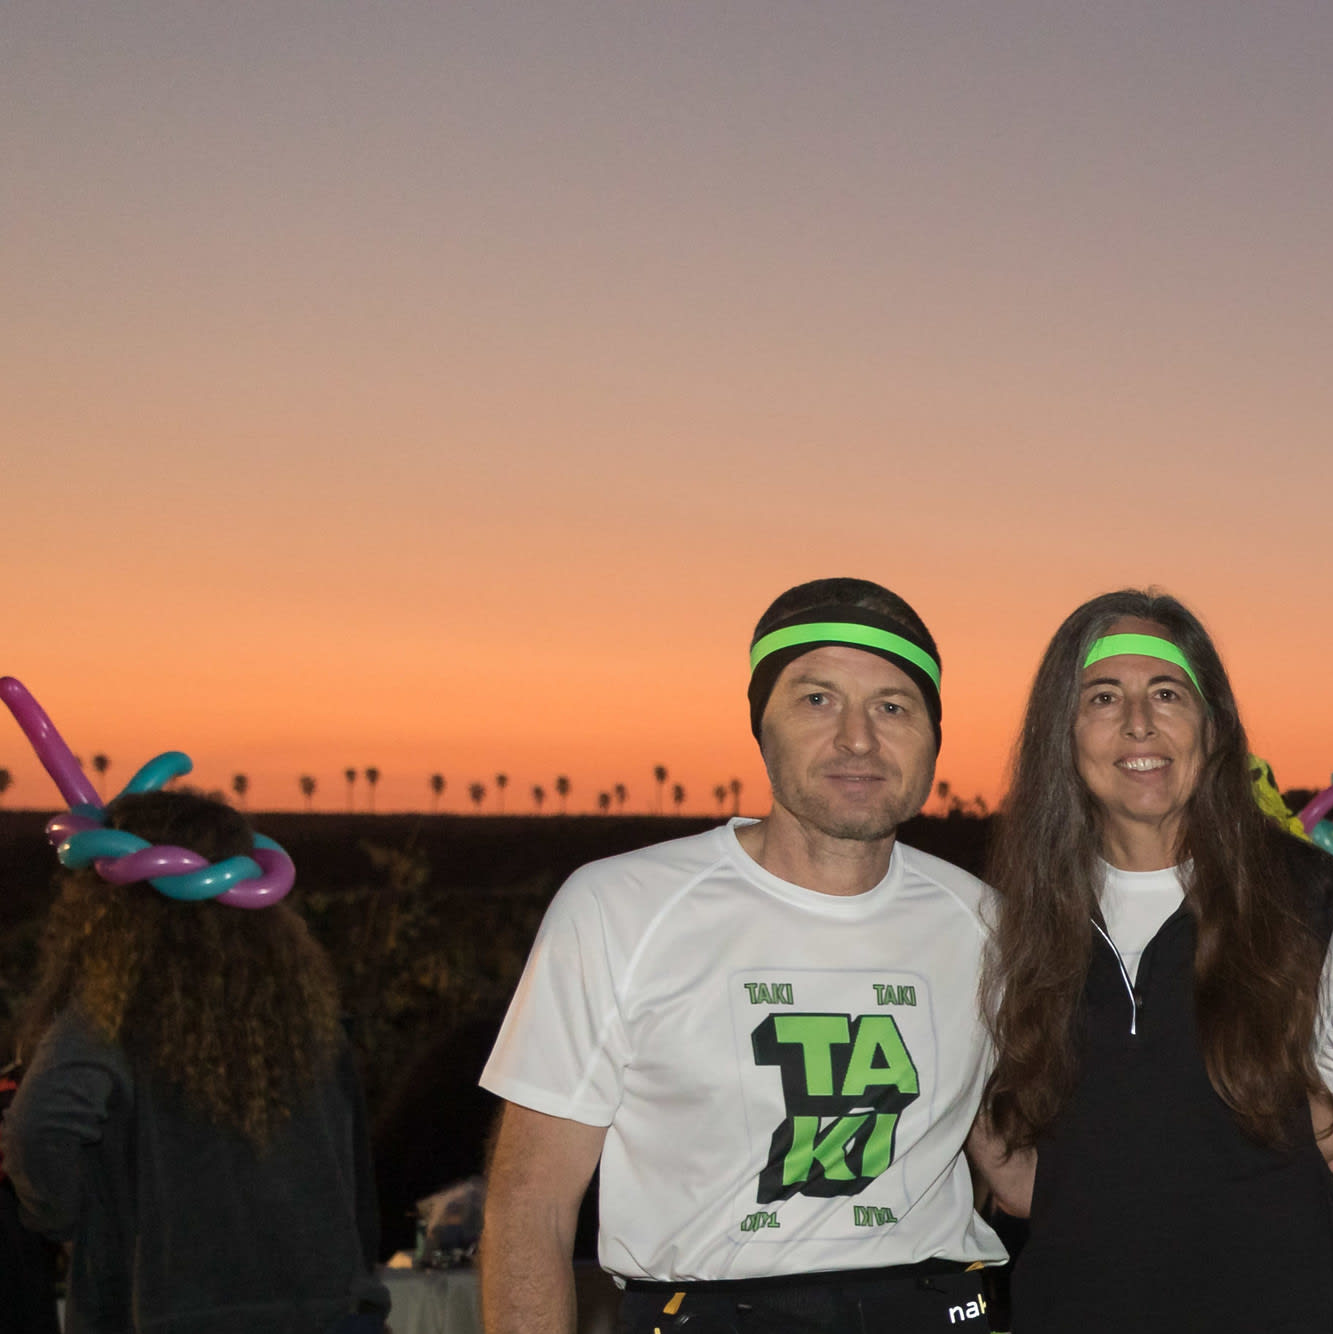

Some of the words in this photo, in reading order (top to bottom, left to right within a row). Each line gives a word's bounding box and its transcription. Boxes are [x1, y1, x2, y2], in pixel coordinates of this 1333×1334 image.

[744, 983, 794, 1005] TAKI
[873, 984, 916, 1006] TAKI
[751, 1013, 920, 1099] TA
[757, 1113, 900, 1192] KI
[854, 1205, 897, 1226] TAKI
